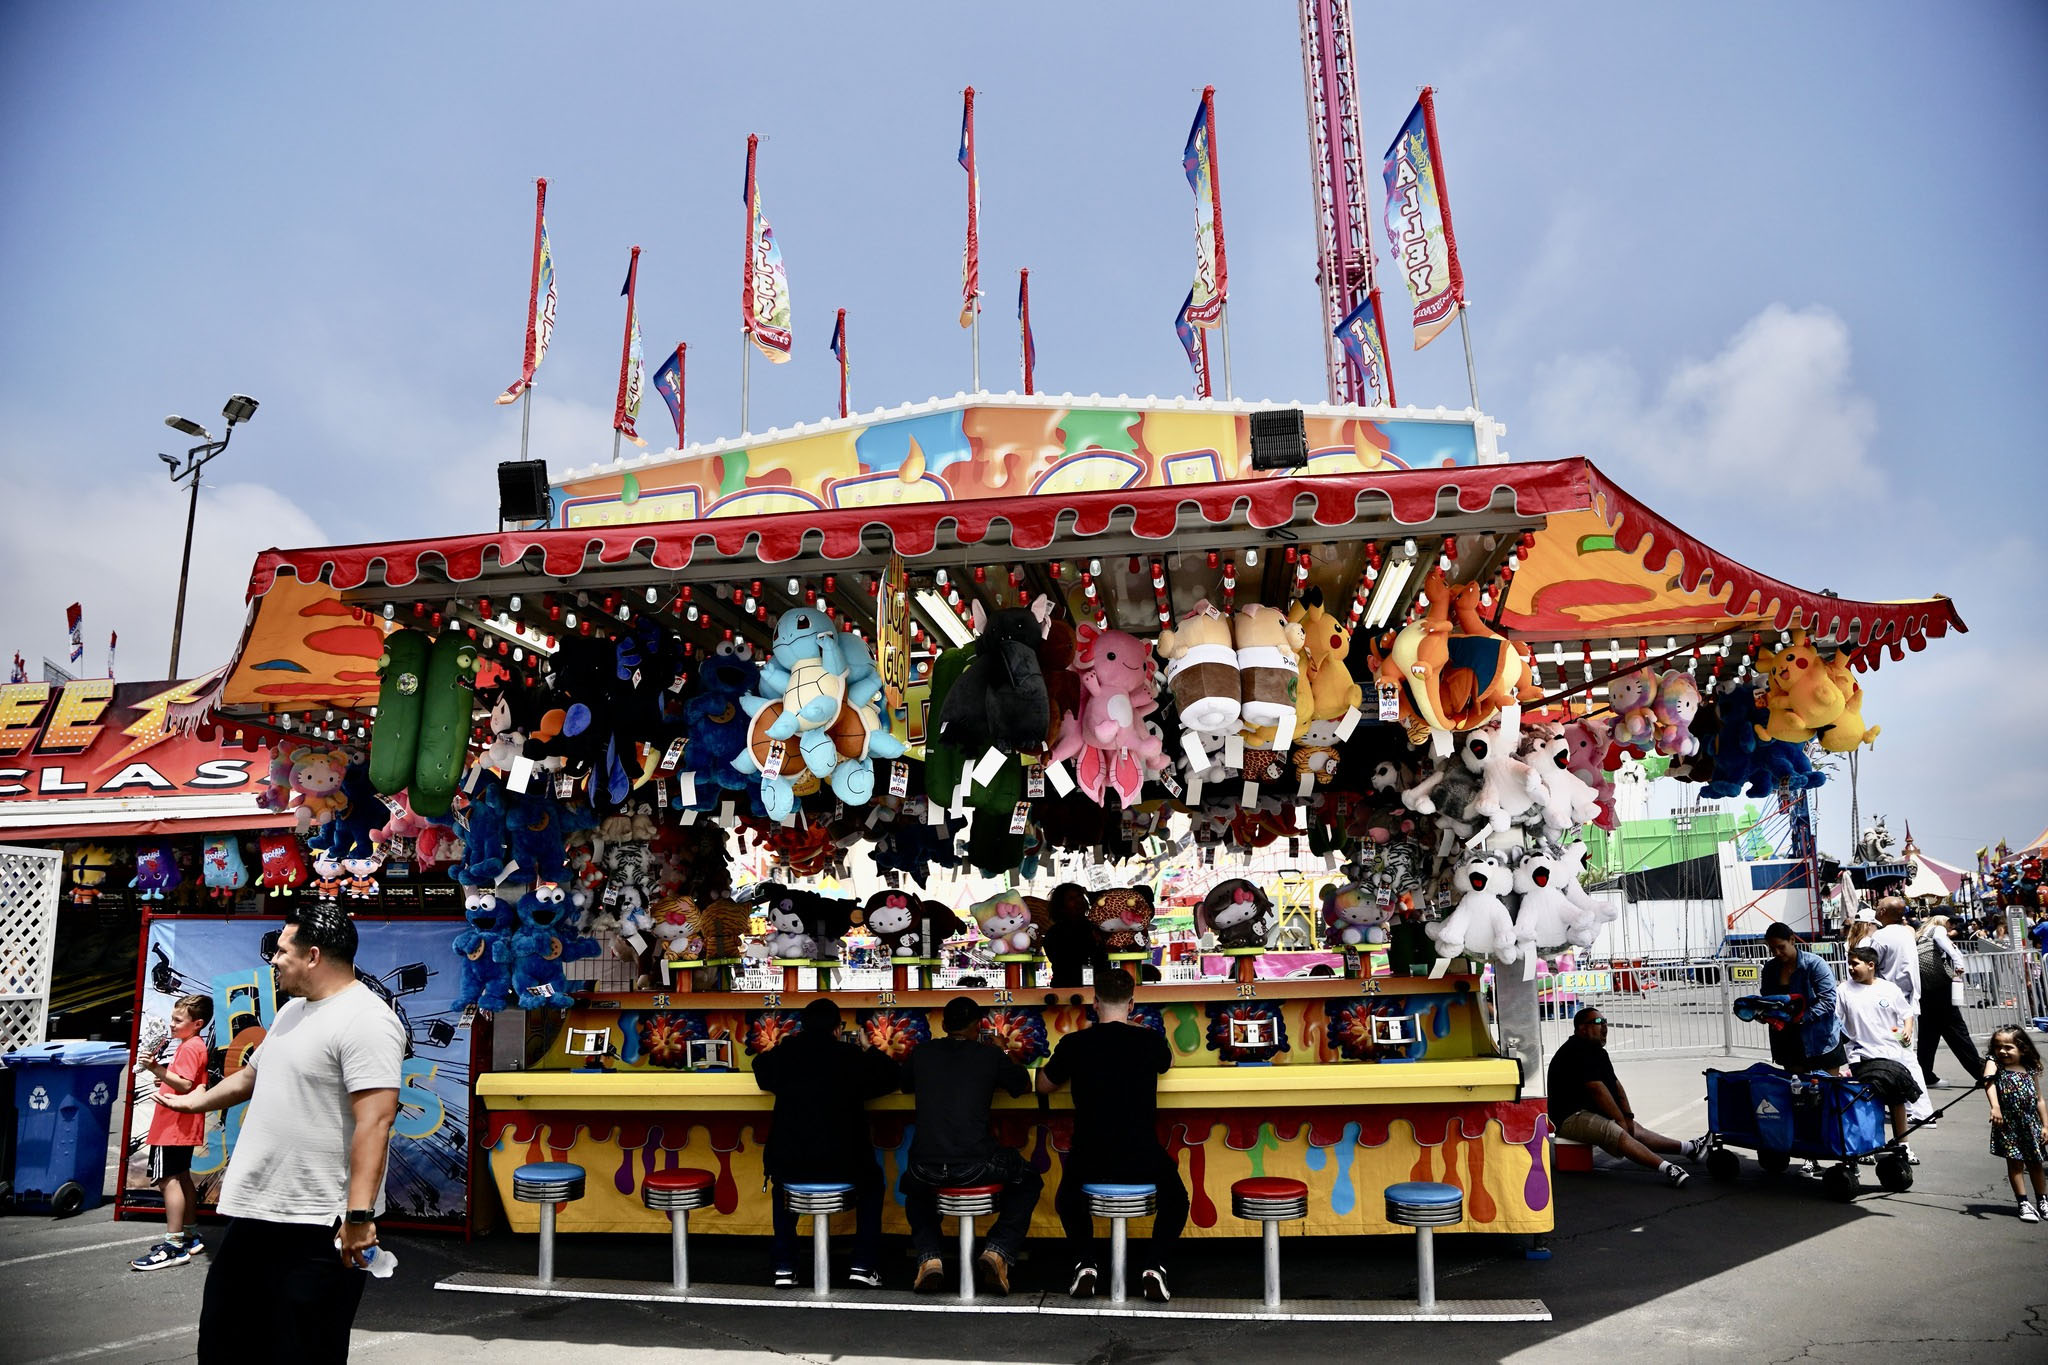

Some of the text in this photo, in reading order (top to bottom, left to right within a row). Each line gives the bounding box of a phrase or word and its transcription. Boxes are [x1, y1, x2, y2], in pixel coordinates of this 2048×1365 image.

[755, 215, 777, 321] LLEY
[886, 582, 906, 635] TOP
[884, 641, 906, 694] GLO
[0, 759, 270, 797] LAS
[892, 776, 906, 785] WON
[1736, 968, 1755, 978] EXIT
[1364, 980, 1377, 992] 14
[1565, 974, 1608, 989] EXIT
[999, 990, 1009, 1001] 11
[1240, 984, 1252, 996] 13
[658, 994, 666, 1005] 8
[769, 994, 776, 1004] 9
[881, 993, 894, 1003] 10
